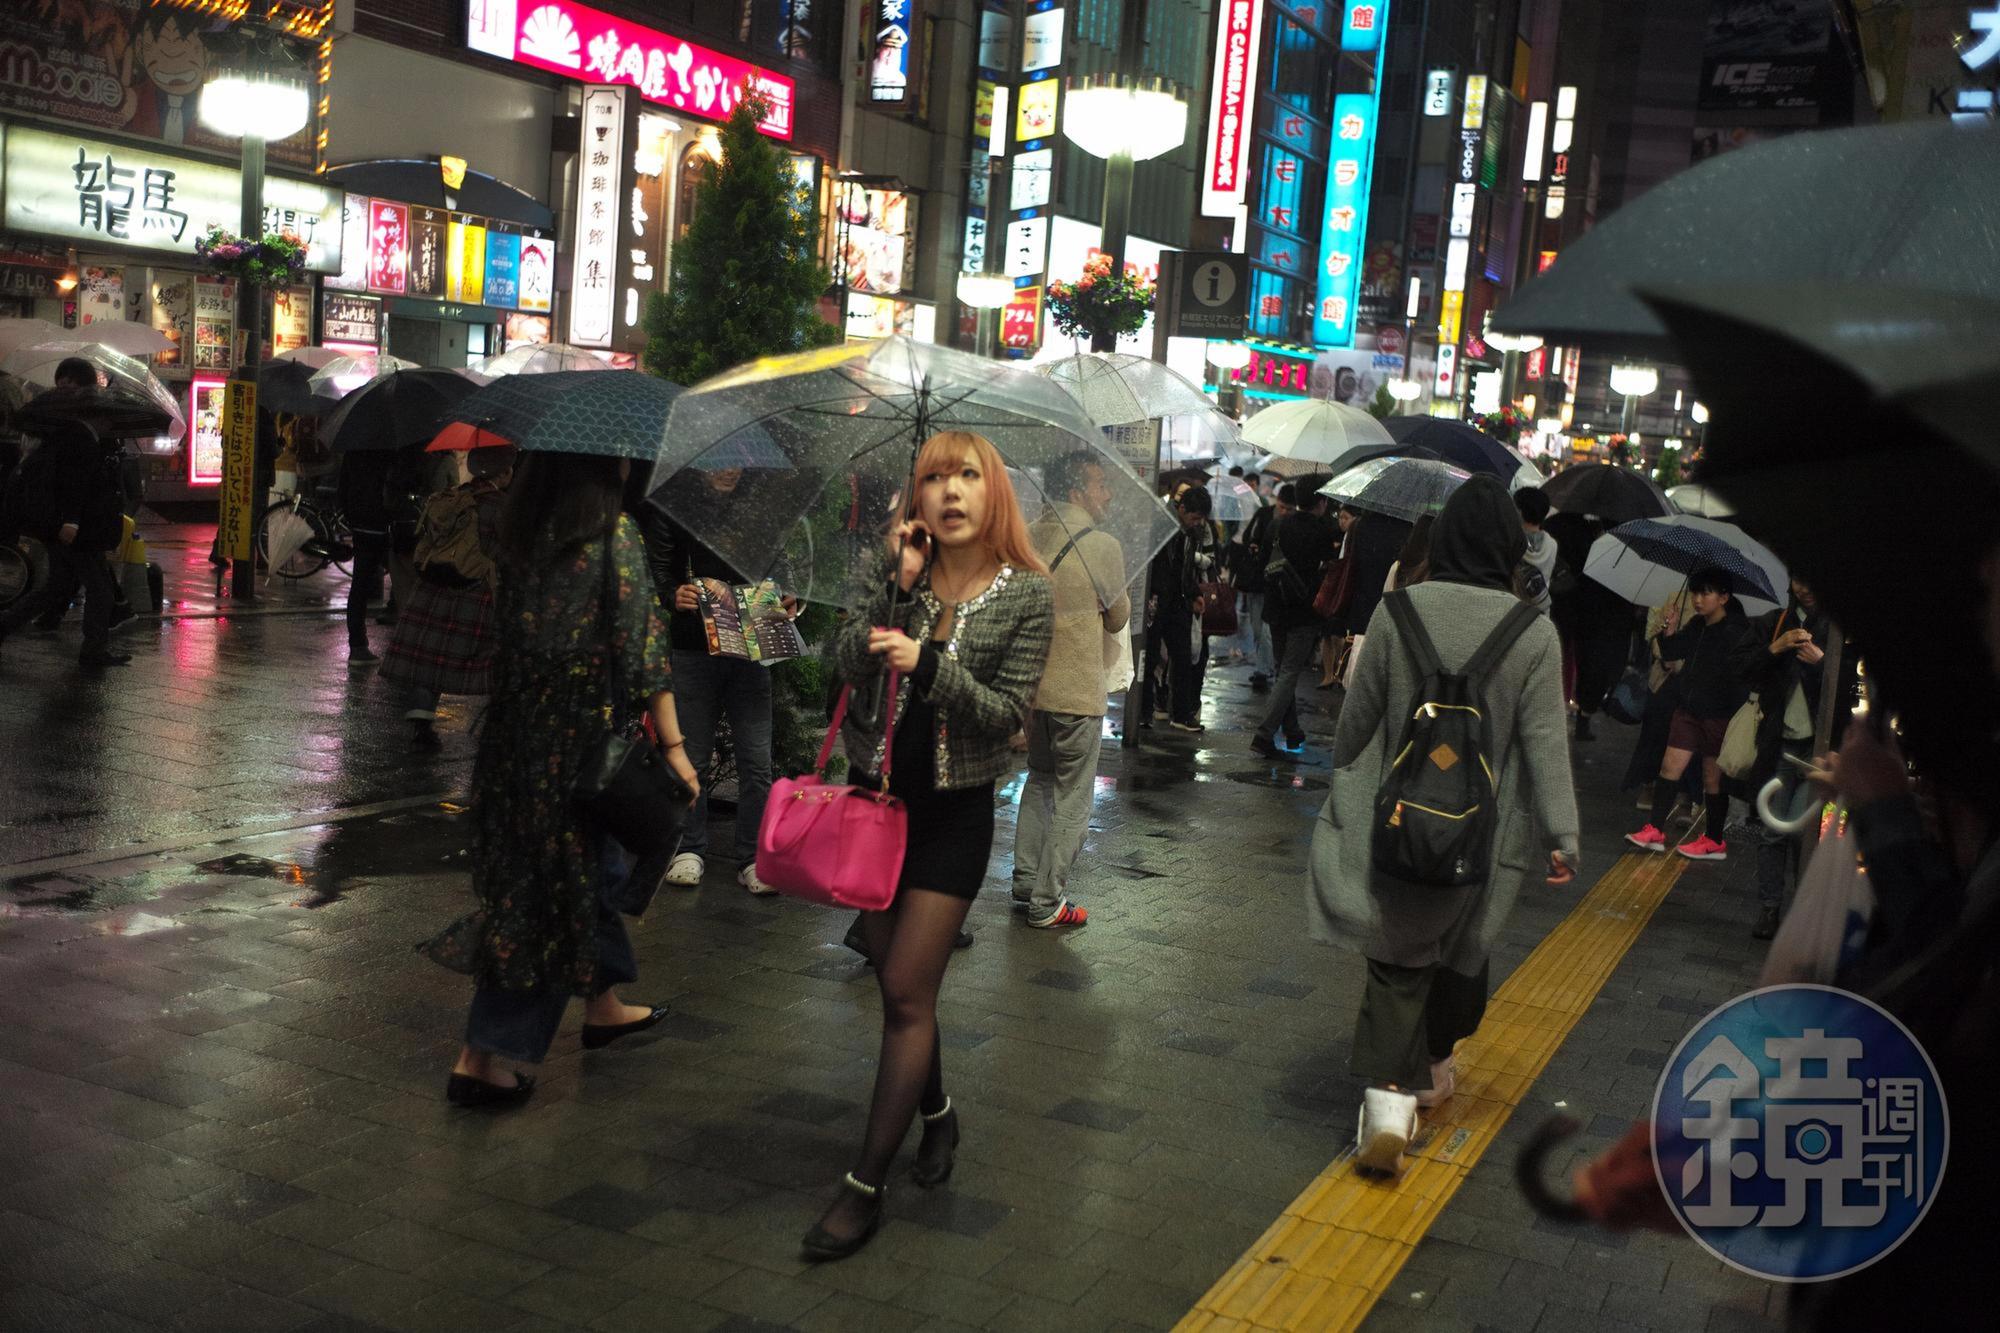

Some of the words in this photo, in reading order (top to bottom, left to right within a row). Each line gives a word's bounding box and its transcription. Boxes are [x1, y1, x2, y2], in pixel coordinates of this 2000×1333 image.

[1226, 33, 1246, 105] CAMERA
[1712, 63, 1771, 86] ICE
[72, 146, 188, 244] 龍馬
[1320, 113, 1365, 327] カラオケ館
